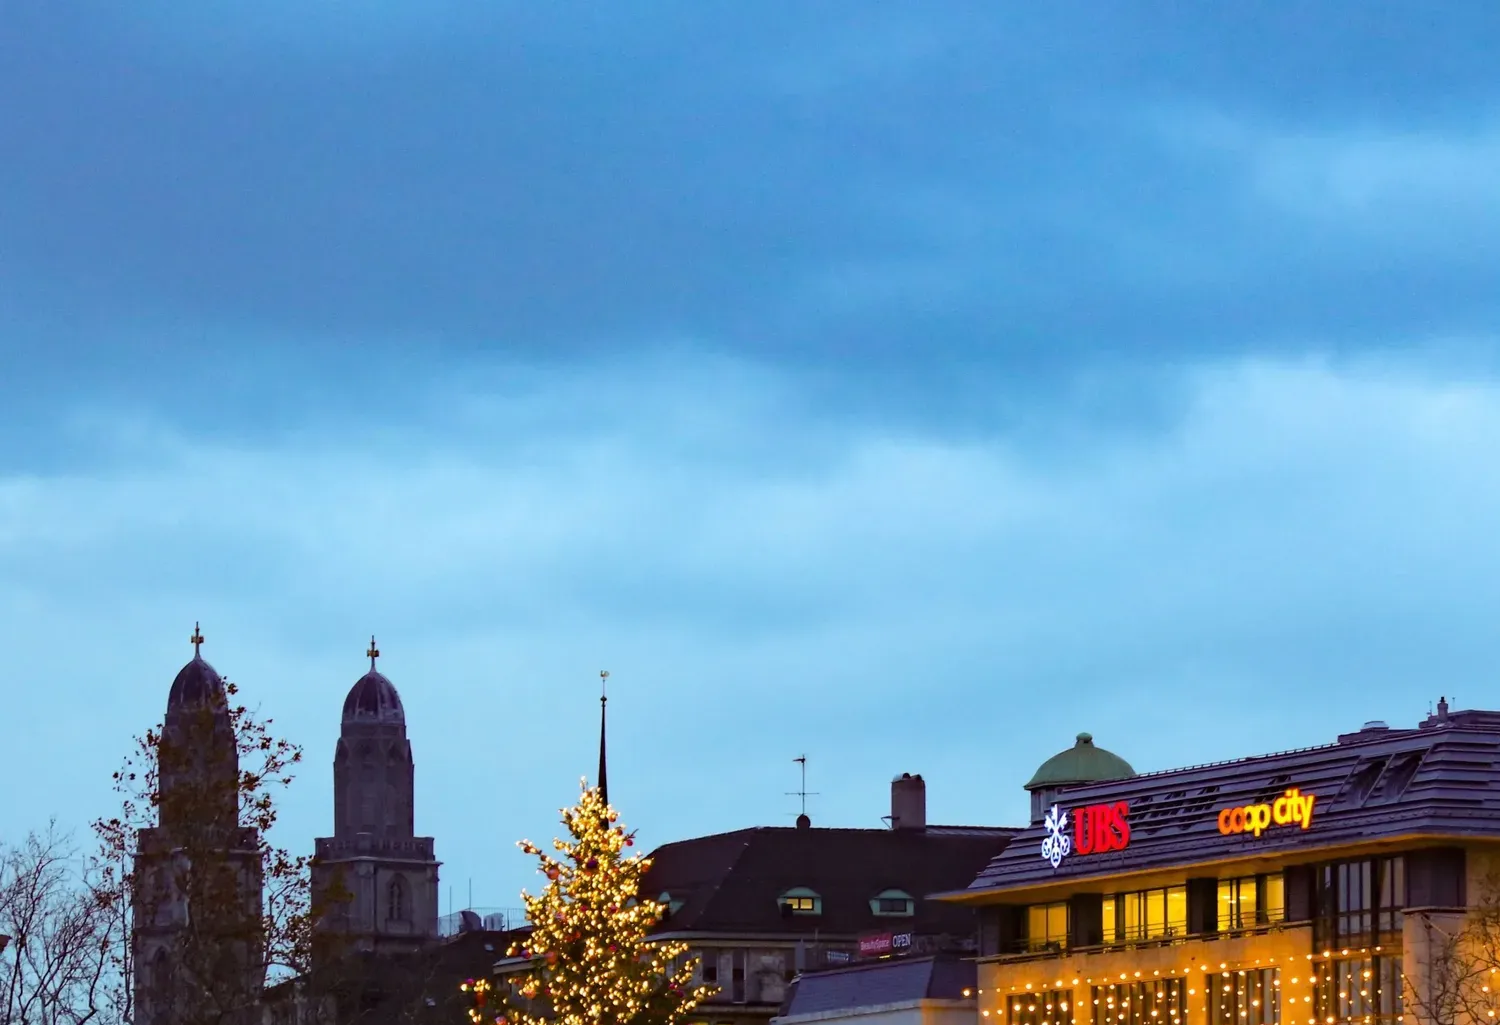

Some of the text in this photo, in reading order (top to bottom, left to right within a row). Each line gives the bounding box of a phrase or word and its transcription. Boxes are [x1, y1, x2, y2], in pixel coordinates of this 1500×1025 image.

[1074, 802, 1130, 855] UBS
[1218, 788, 1315, 836] coop city
[892, 933, 912, 948] OPEN
